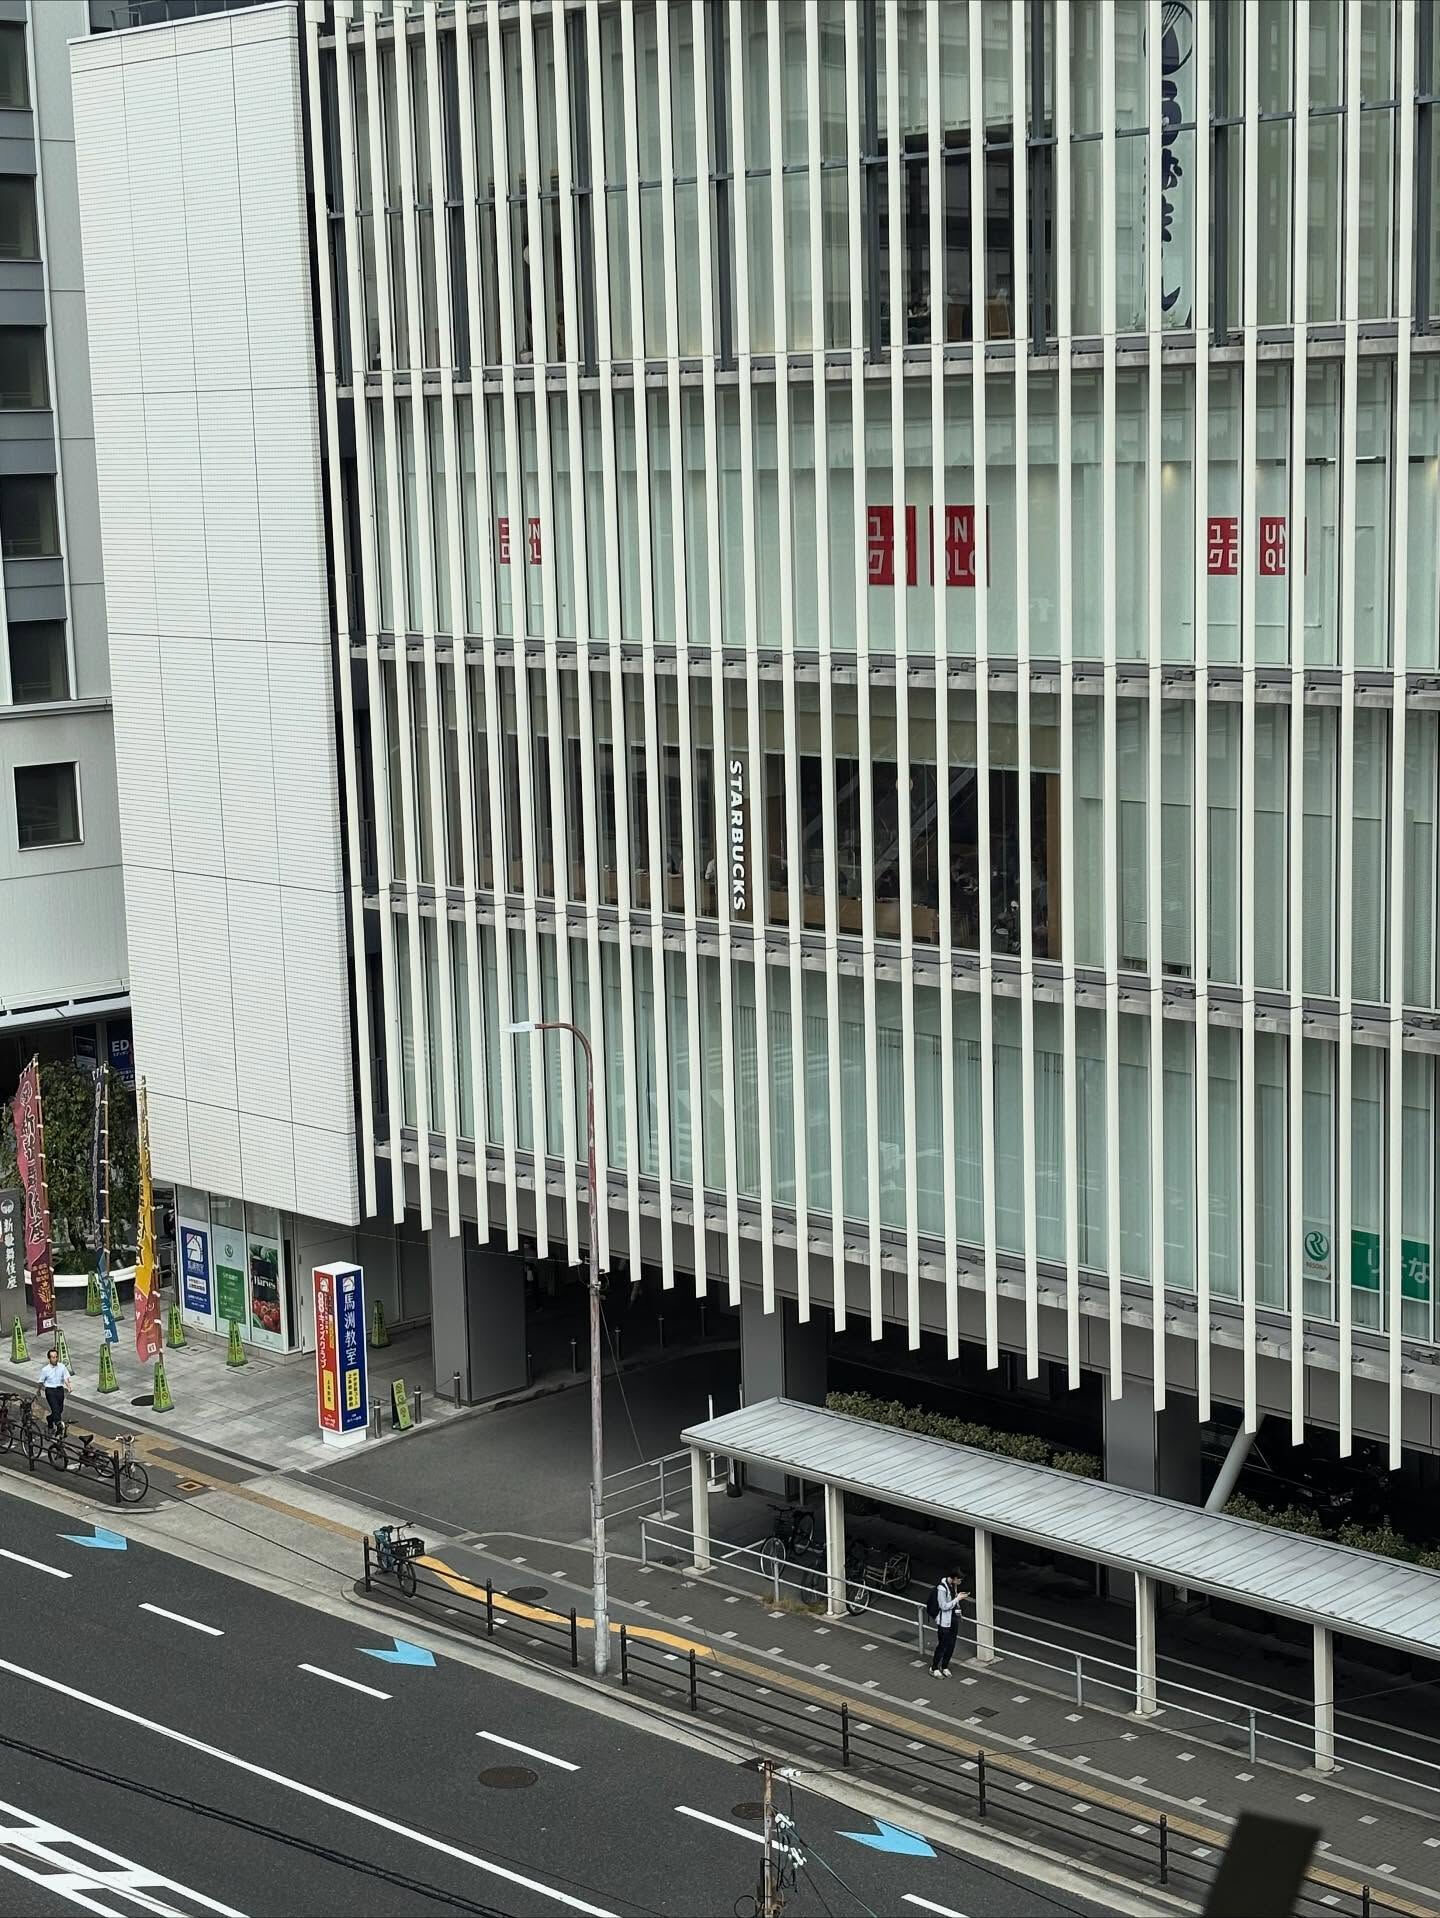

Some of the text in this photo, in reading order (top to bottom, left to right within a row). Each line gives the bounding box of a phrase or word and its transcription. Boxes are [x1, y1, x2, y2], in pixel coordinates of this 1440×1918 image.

[1265, 524, 1287, 544] UN
[1265, 548, 1287, 571] QL
[730, 760, 746, 911] STARBUCKS
[3, 1217, 18, 1289] 新歌舞伎座
[1367, 1248, 1430, 1284] りな
[343, 1291, 358, 1367] 馬渕教室
